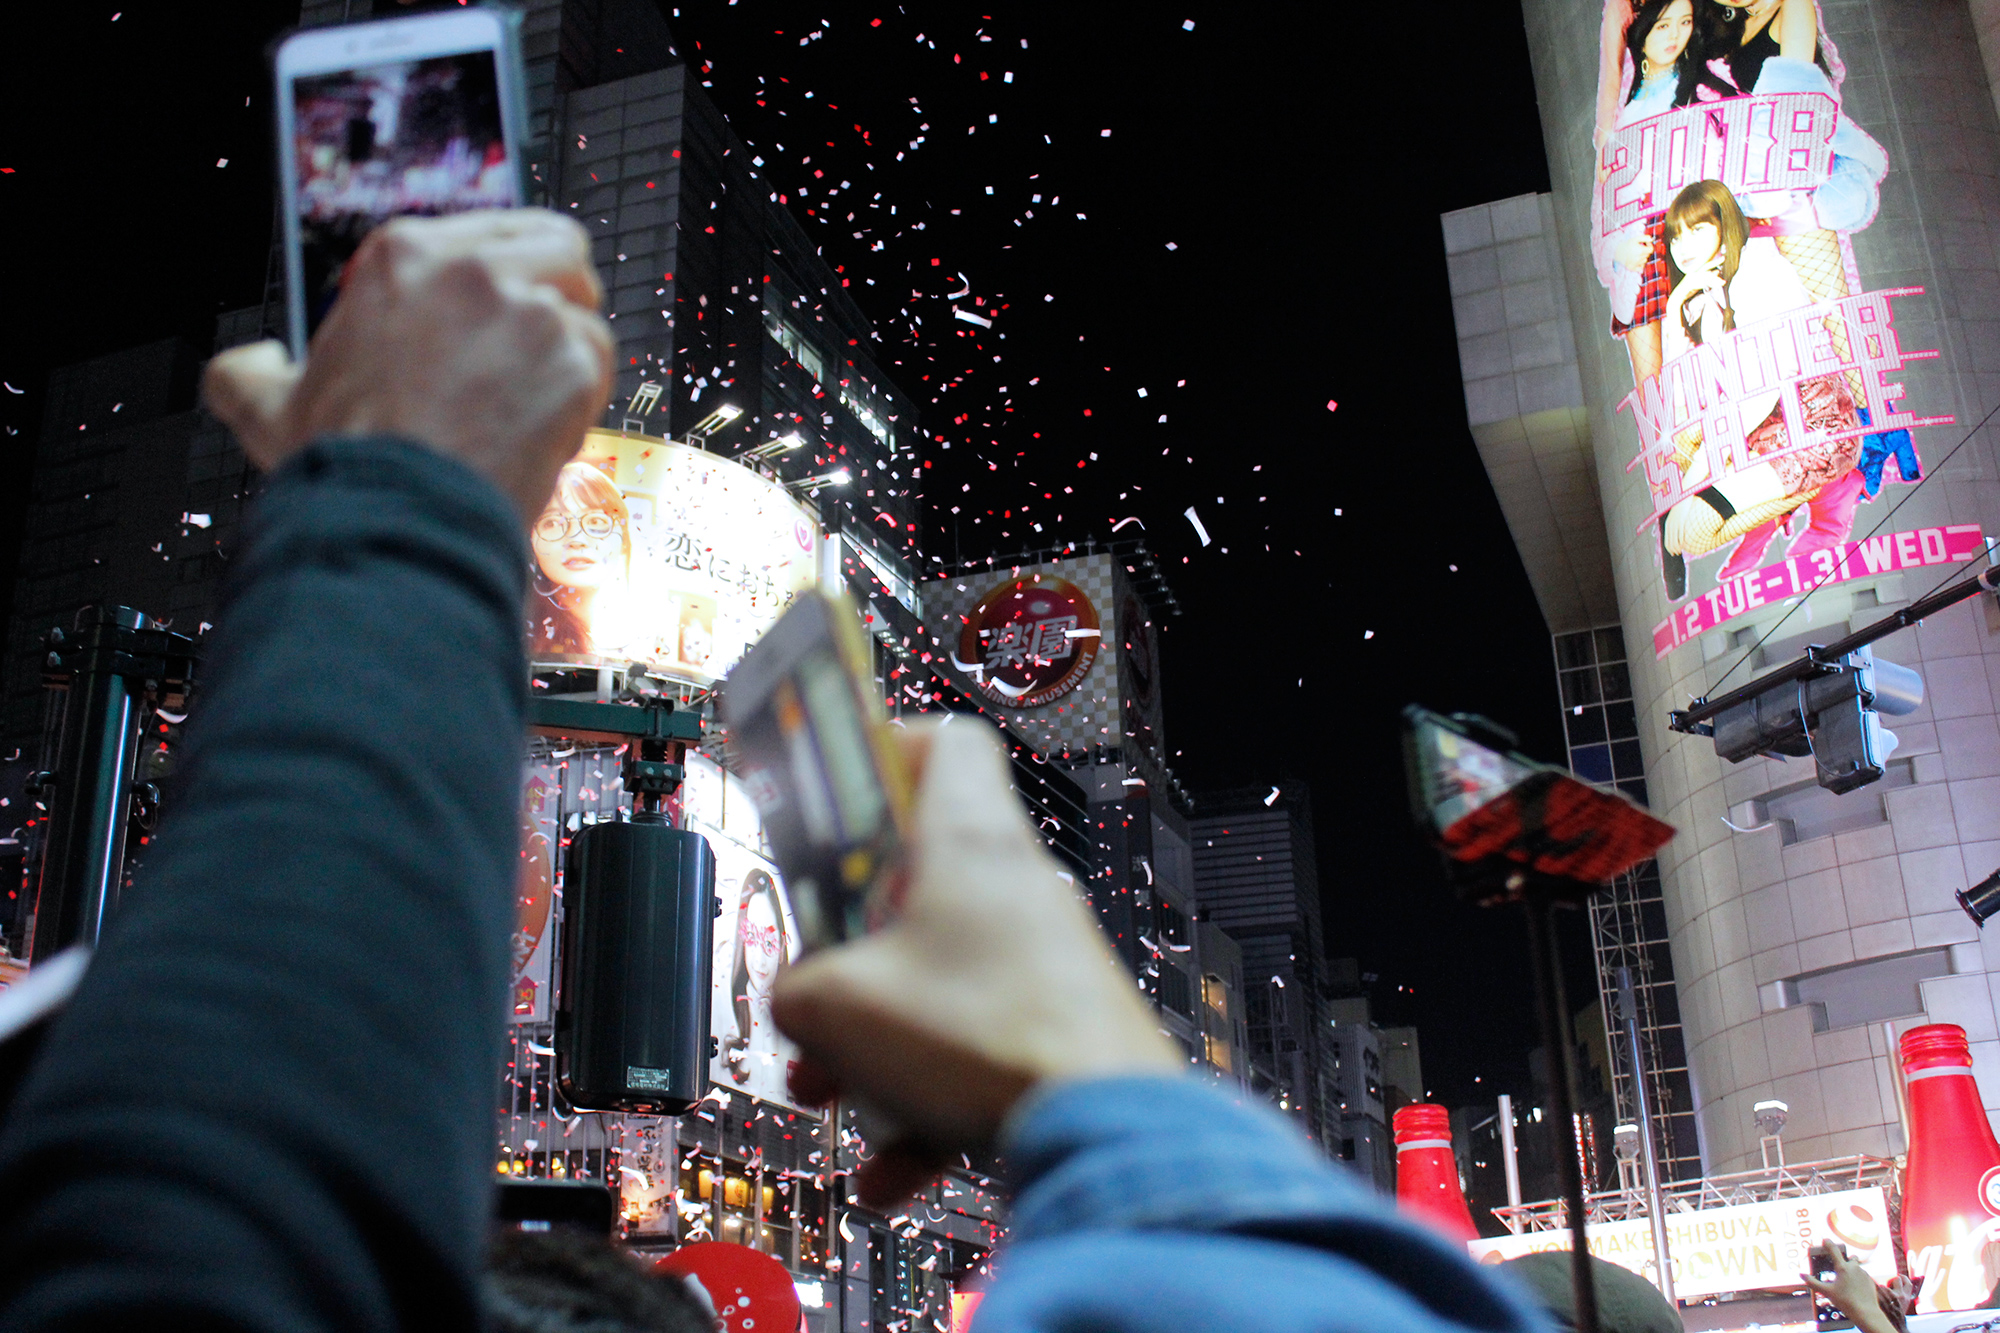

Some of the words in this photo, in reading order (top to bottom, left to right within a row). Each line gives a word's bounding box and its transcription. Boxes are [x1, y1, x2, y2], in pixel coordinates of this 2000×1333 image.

[1600, 92, 1839, 237] 2018
[1617, 286, 1939, 474] WINTER
[1636, 364, 1954, 535] SALE
[1669, 603, 1702, 645] 1.2
[1858, 527, 1947, 575] WED
[983, 614, 1078, 671] 楽園
[1022, 651, 1095, 708] AMUSEMENT
[1586, 1230, 1654, 1256] MAKE
[1665, 1215, 1773, 1247] SHIBUYA
[1784, 1231, 1801, 1270] 2017
[1796, 1208, 1814, 1249] 2018
